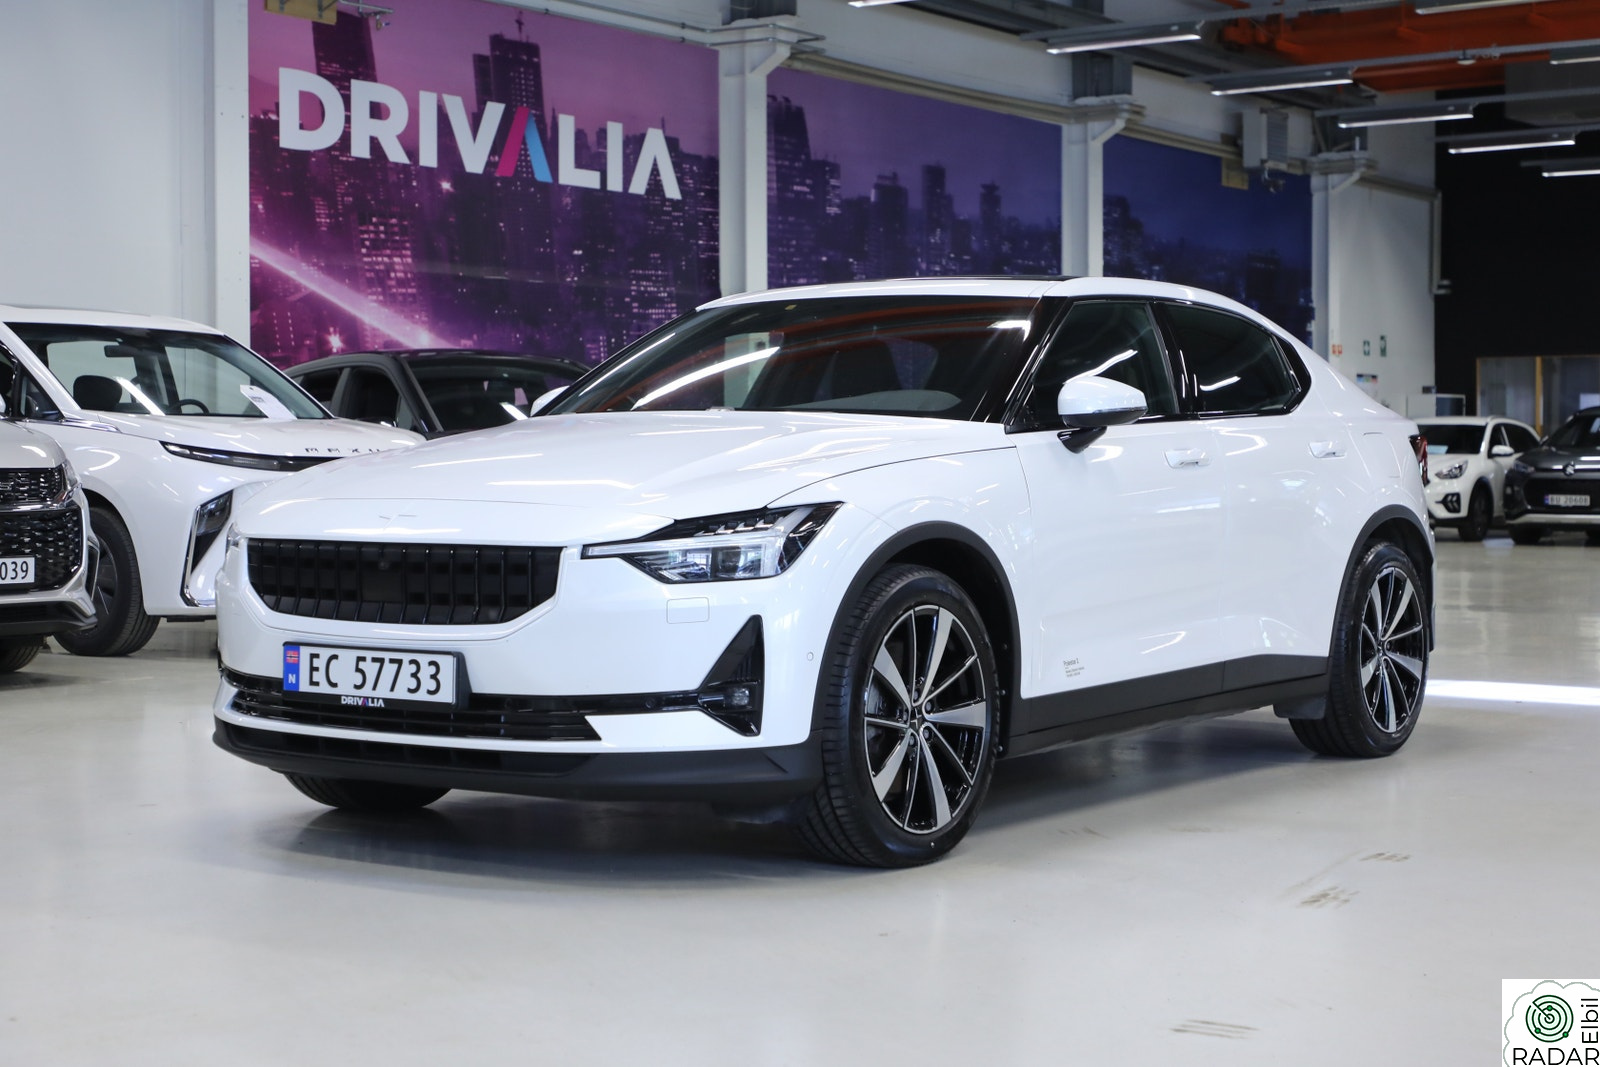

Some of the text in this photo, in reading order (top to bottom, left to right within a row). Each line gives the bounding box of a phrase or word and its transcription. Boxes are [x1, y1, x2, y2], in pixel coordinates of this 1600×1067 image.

[278, 66, 683, 200] DRIVALIA
[288, 673, 296, 684] N
[308, 652, 442, 696] EC 57733
[340, 695, 385, 708] DRIVALIA
